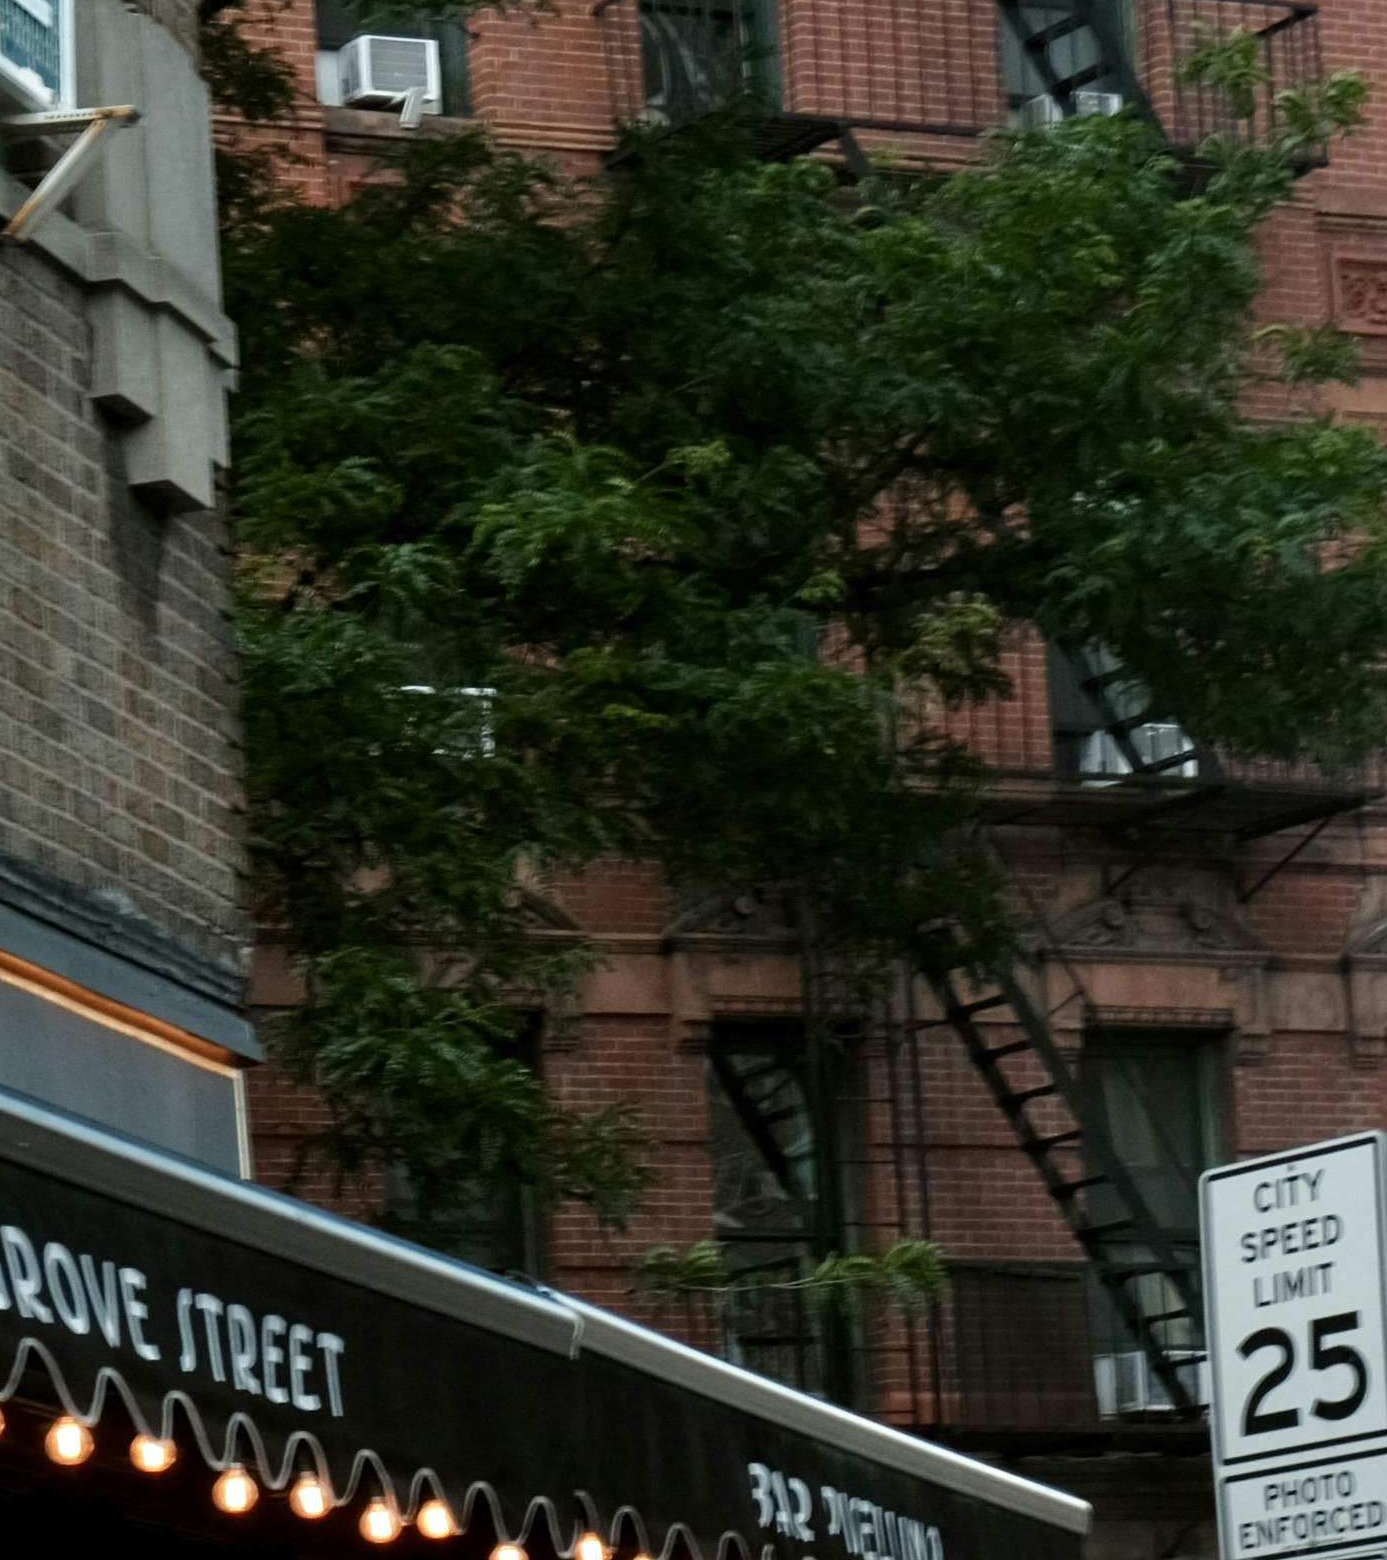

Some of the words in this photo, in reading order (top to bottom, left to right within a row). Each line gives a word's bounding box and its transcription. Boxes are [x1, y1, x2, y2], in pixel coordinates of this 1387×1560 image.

[1254, 1169, 1325, 1213] CITY
[1241, 1213, 1343, 1264] SPEED
[1254, 1262, 1335, 1308] LIMIT
[176, 1288, 345, 1417] STREET
[1236, 1310, 1369, 1438] 25
[747, 1462, 815, 1542] BAR
[1265, 1470, 1355, 1512] PHOTO
[1240, 1500, 1385, 1550] ENFORCED
